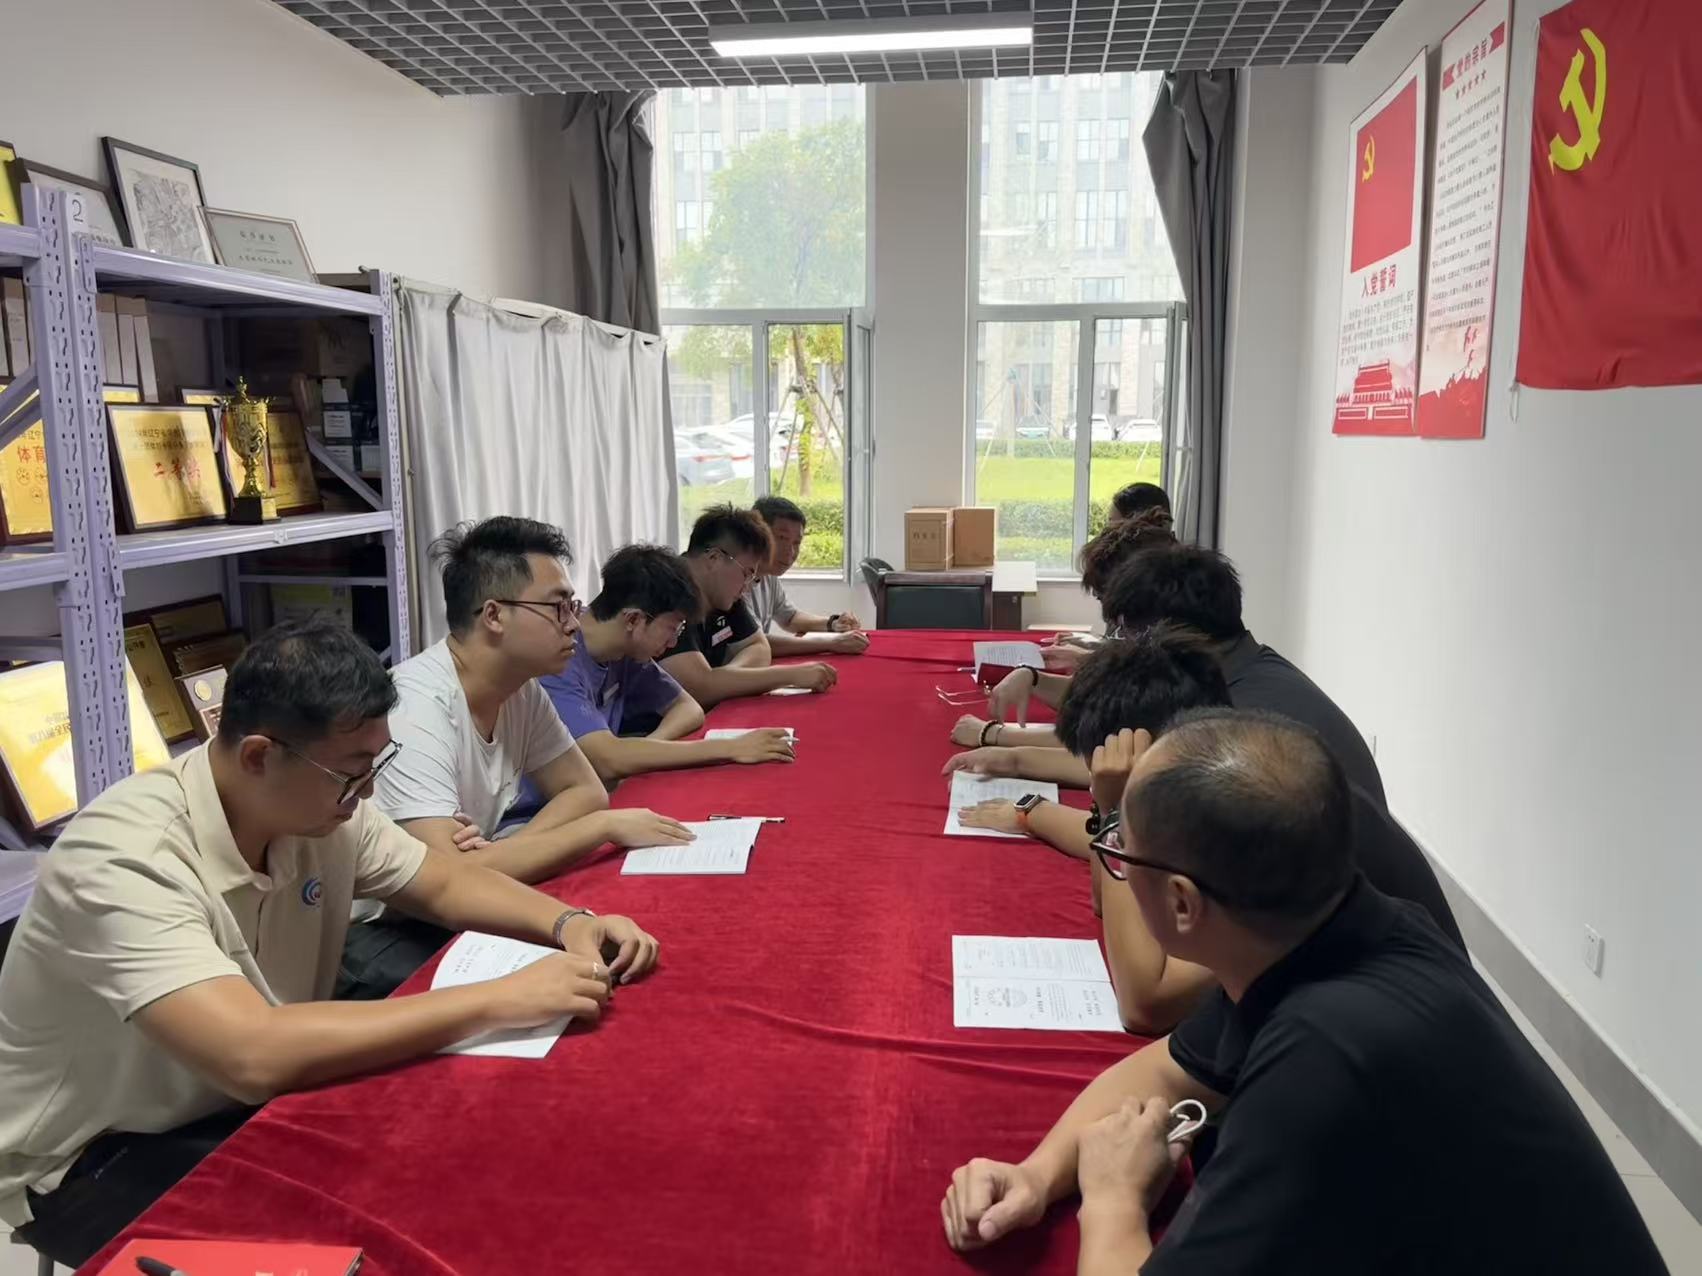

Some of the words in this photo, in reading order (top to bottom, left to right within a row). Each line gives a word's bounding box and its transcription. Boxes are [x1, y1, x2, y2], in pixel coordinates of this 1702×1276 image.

[71, 199, 84, 222] 2
[1361, 264, 1397, 298] 入党誓词
